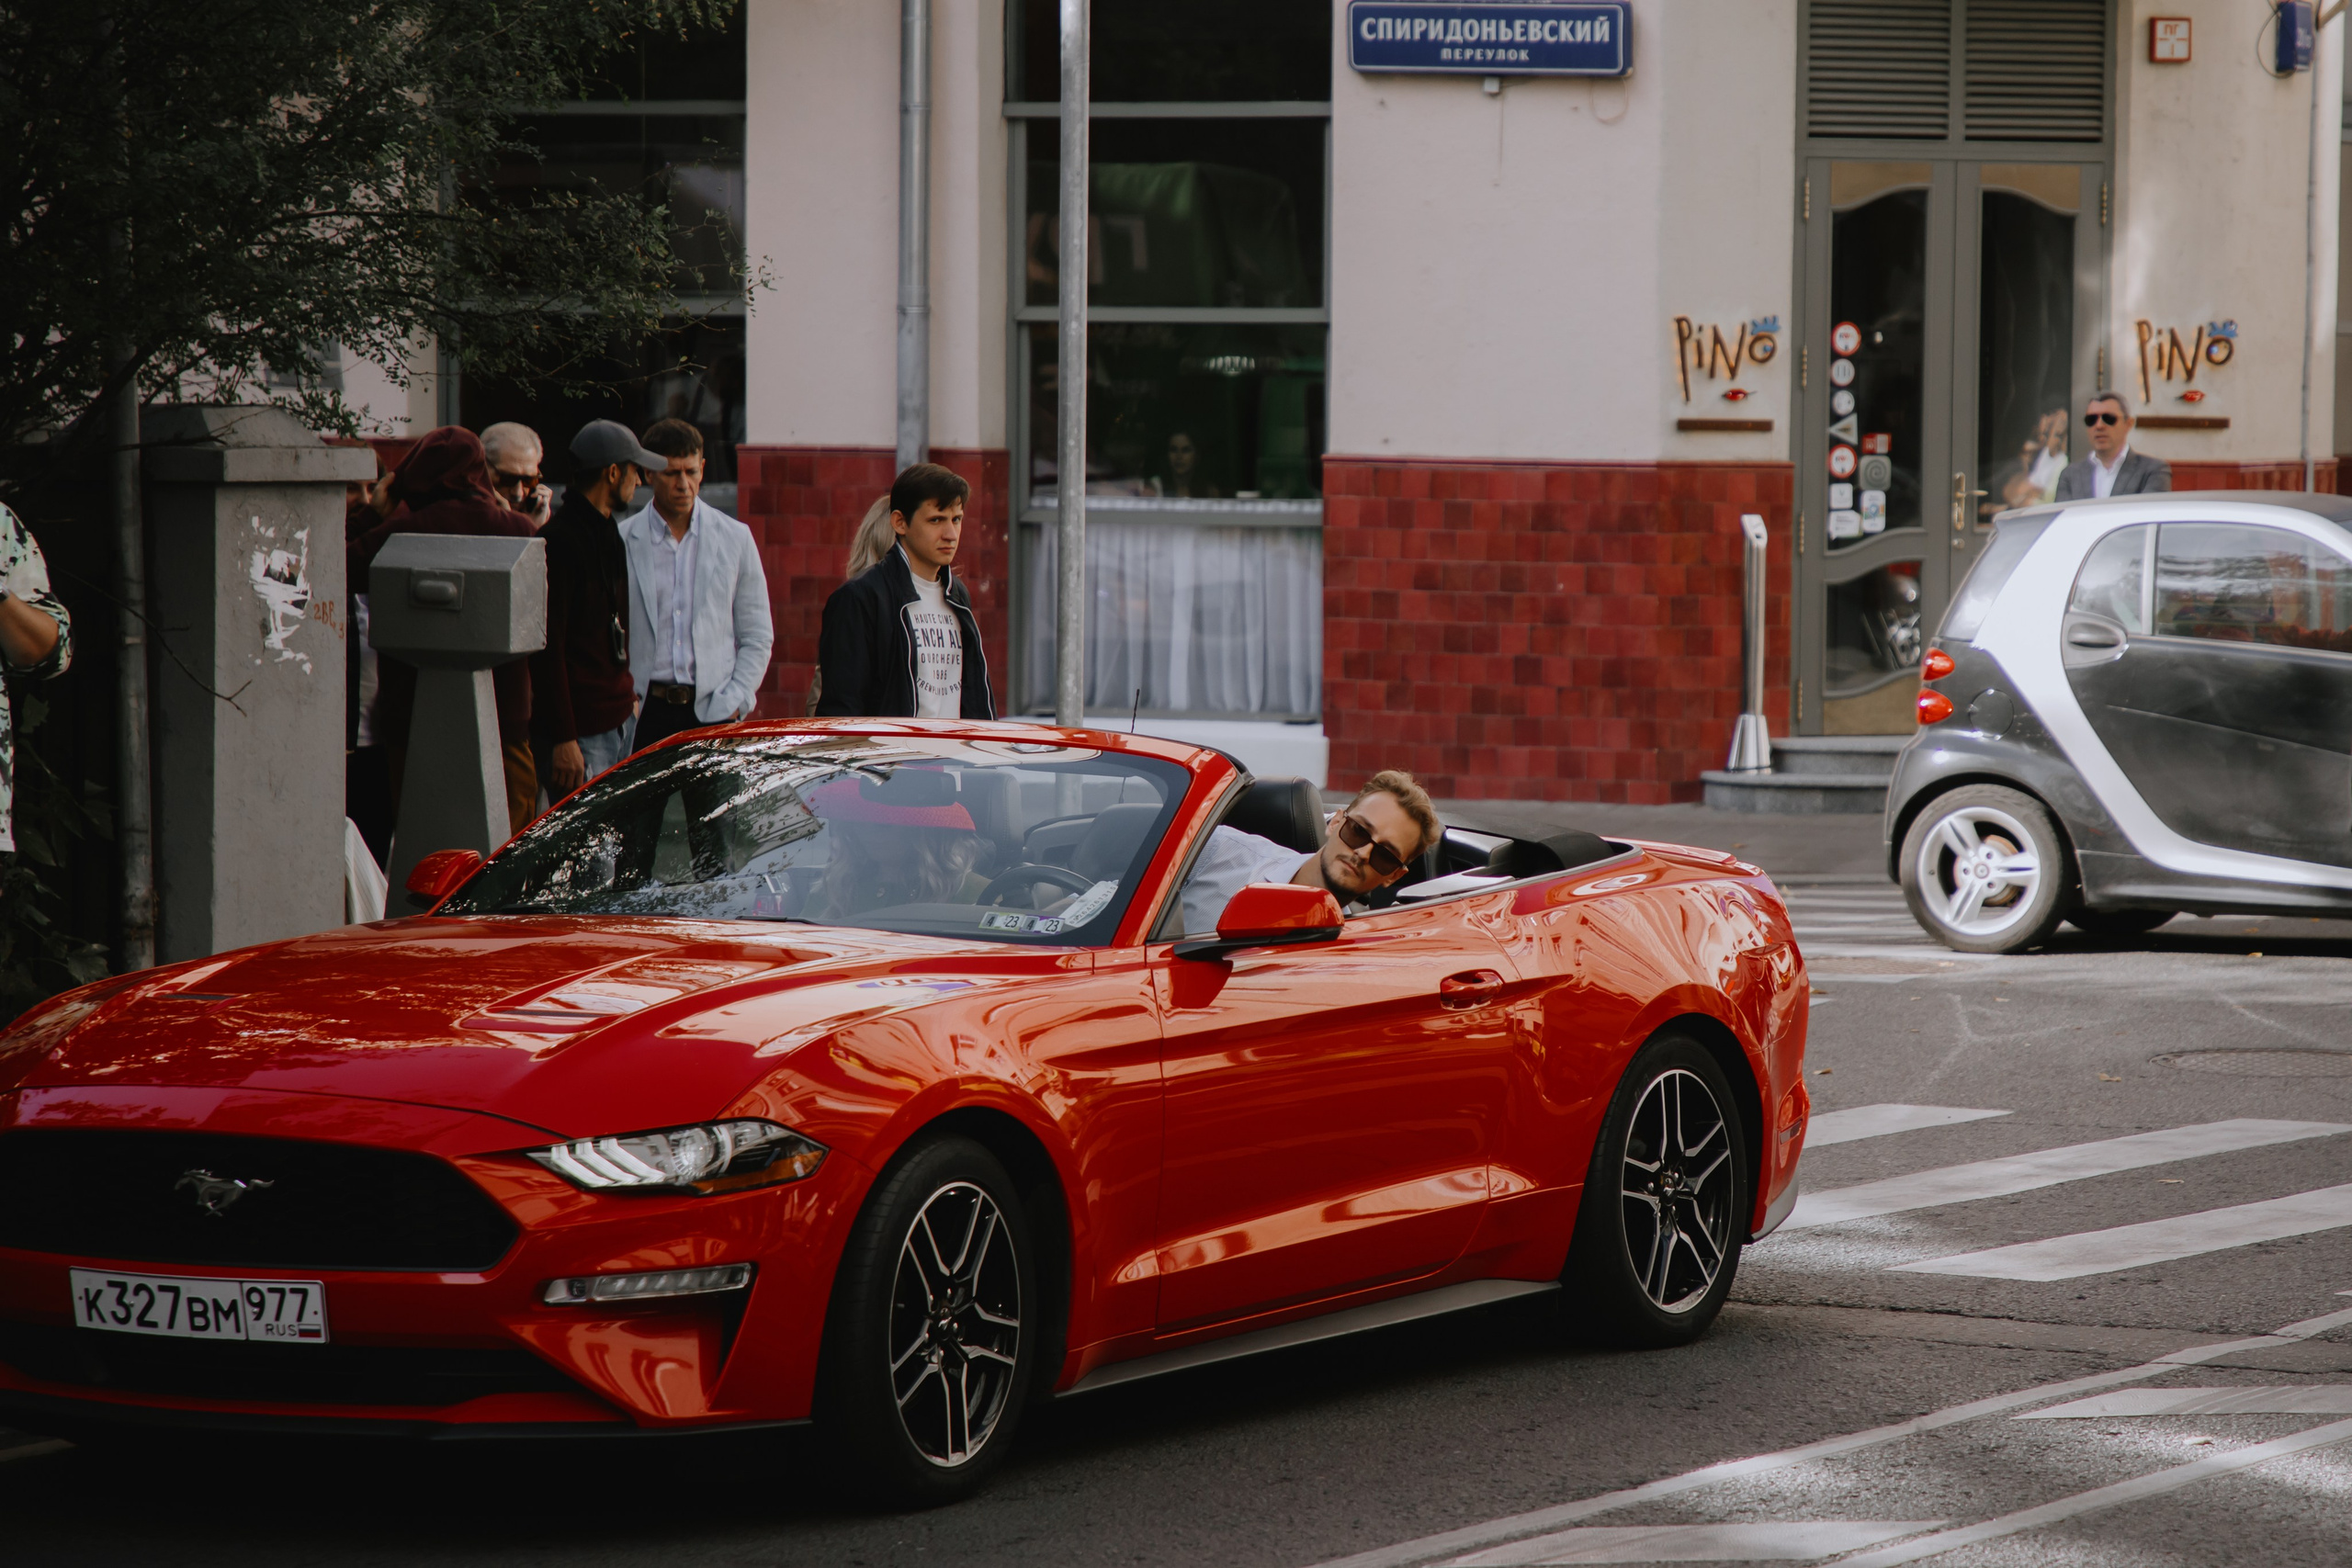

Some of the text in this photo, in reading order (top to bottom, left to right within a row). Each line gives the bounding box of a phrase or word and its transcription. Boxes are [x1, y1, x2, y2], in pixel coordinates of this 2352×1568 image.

[1360, 16, 1611, 43] СПИРИДОНЬЕВСКИЙ
[1440, 48, 1531, 62] ПЕРЕУЛОК
[914, 614, 954, 626] HAUTE CIME
[948, 629, 962, 649] AL
[987, 915, 1020, 928] 4 23
[1027, 919, 1059, 932] 4 23
[246, 1286, 309, 1323] 977
[266, 1323, 297, 1337] RUS
